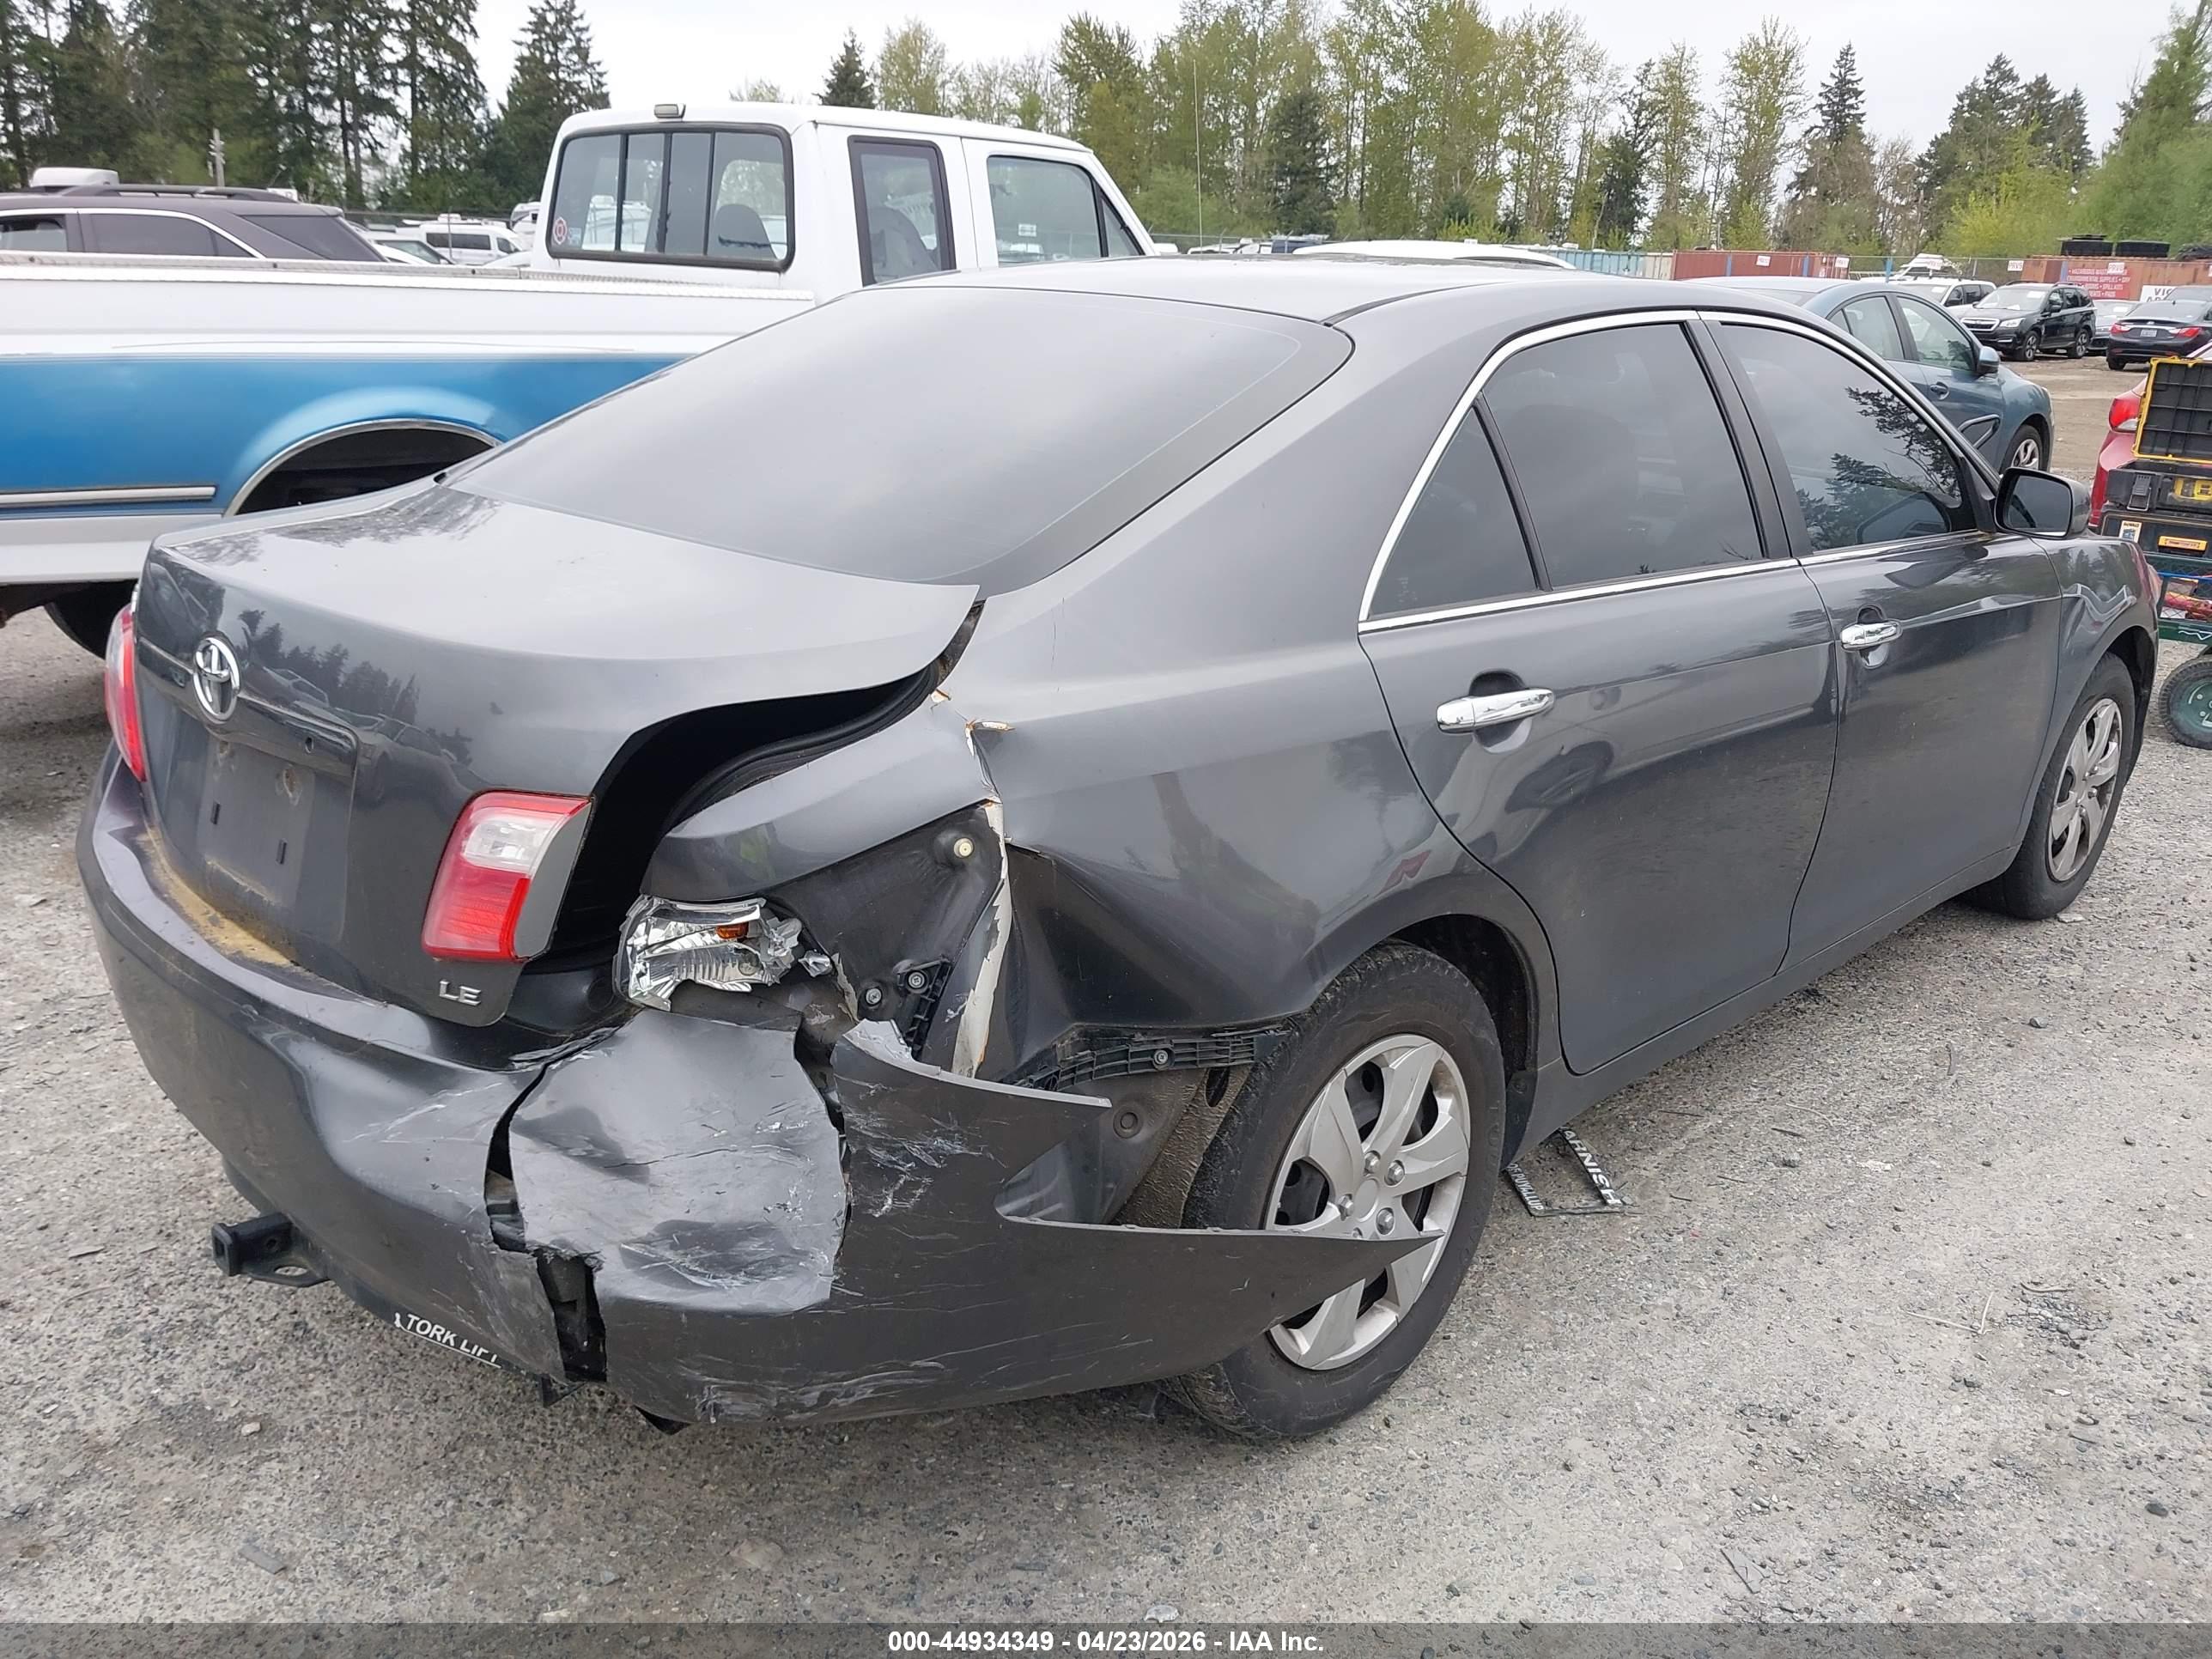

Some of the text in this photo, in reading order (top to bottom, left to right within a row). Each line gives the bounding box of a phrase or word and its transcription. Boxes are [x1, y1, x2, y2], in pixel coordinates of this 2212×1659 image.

[439, 980, 482, 1006] LE
[1559, 1126, 1623, 1206] ARNISH
[1510, 1173, 1545, 1211] PUYALLUP
[407, 1313, 458, 1346] TORK
